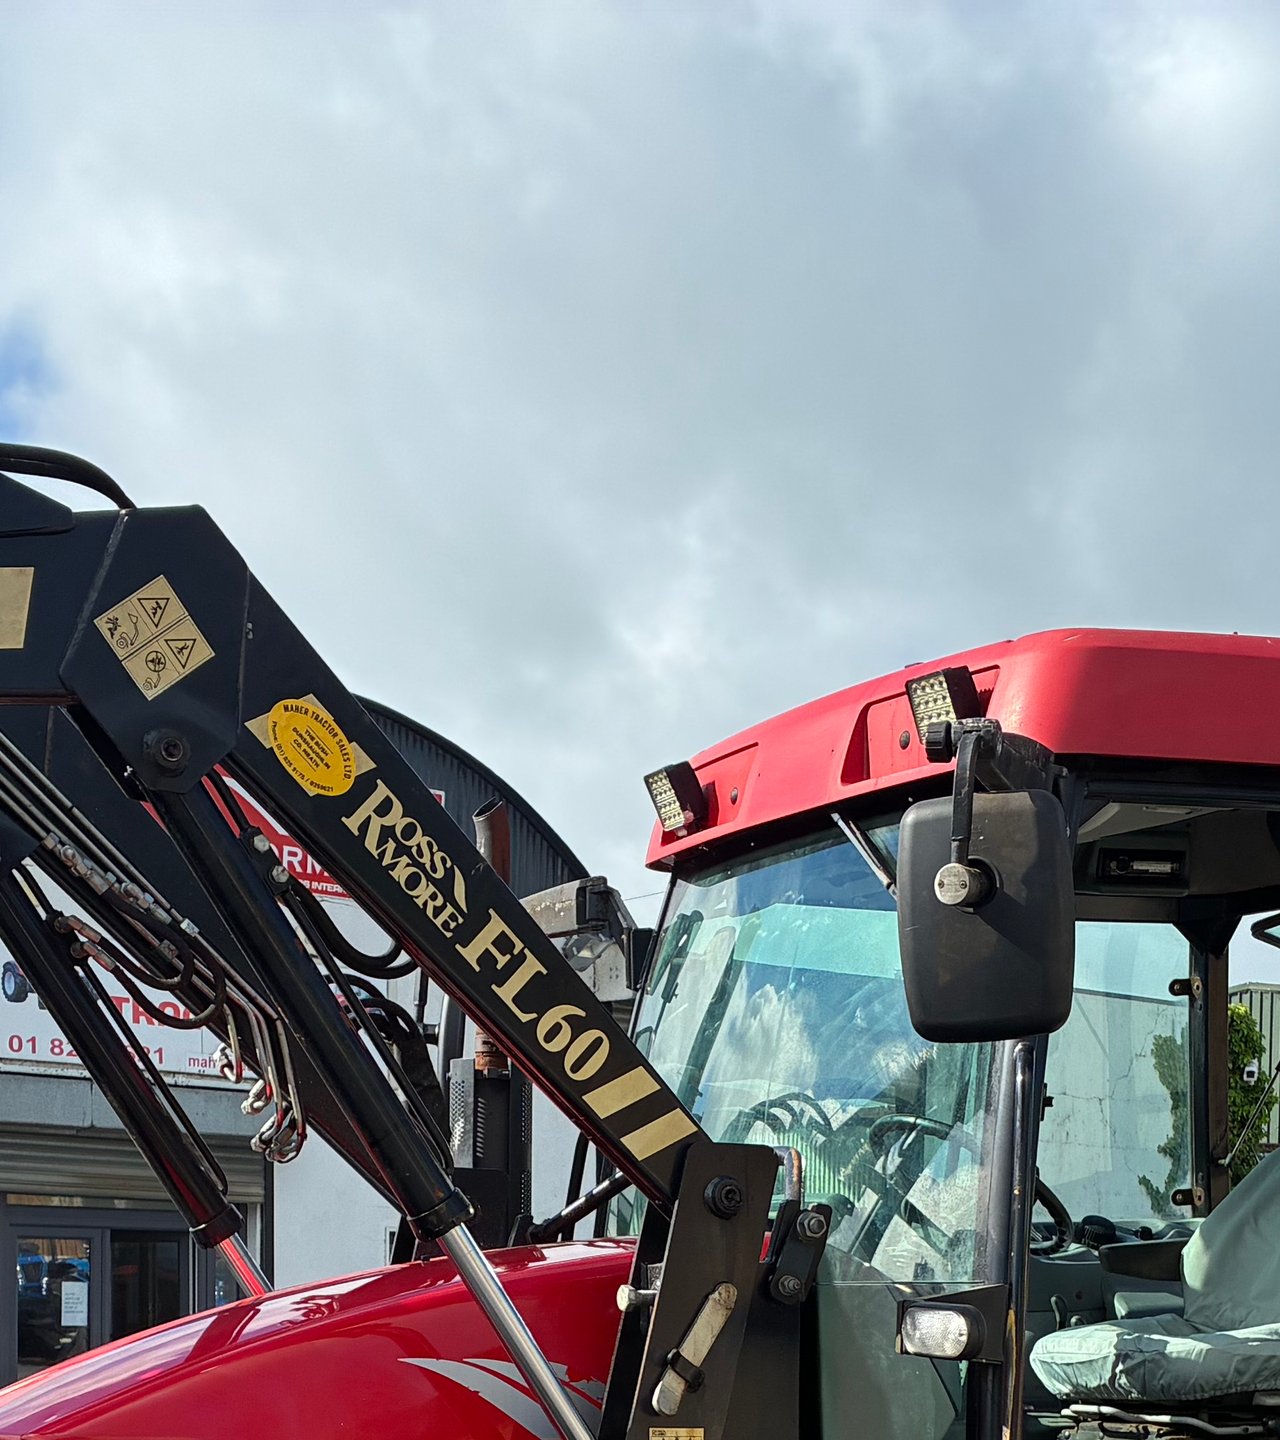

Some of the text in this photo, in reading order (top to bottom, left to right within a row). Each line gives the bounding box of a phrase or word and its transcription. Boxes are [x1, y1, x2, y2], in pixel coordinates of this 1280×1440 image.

[283, 704, 309, 716] MAHER
[310, 711, 339, 739] TRACTOR
[336, 739, 351, 762] SALES
[455, 908, 610, 1081] FL60
[8, 1034, 37, 1054] 01
